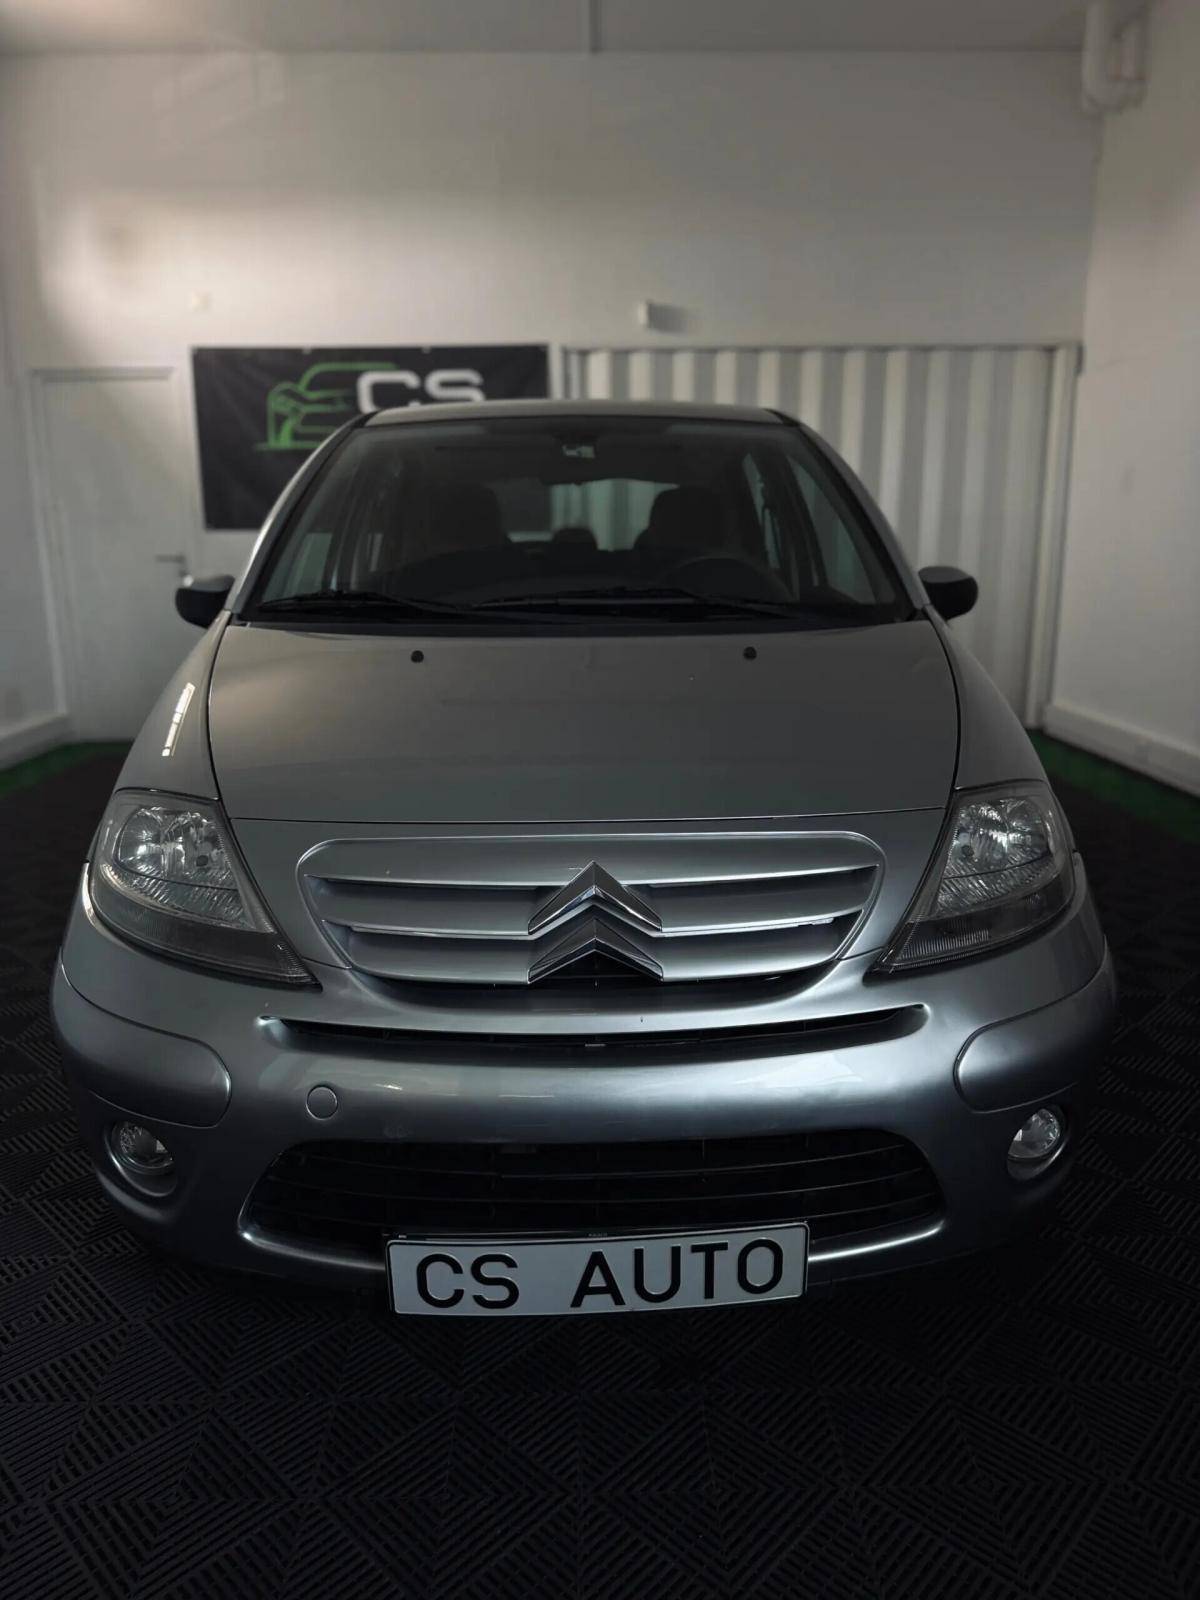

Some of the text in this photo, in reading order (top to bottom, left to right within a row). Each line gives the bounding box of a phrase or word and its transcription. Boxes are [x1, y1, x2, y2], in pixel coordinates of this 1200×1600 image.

[356, 369, 485, 414] CS
[416, 1237, 784, 1310] CS AUTO
